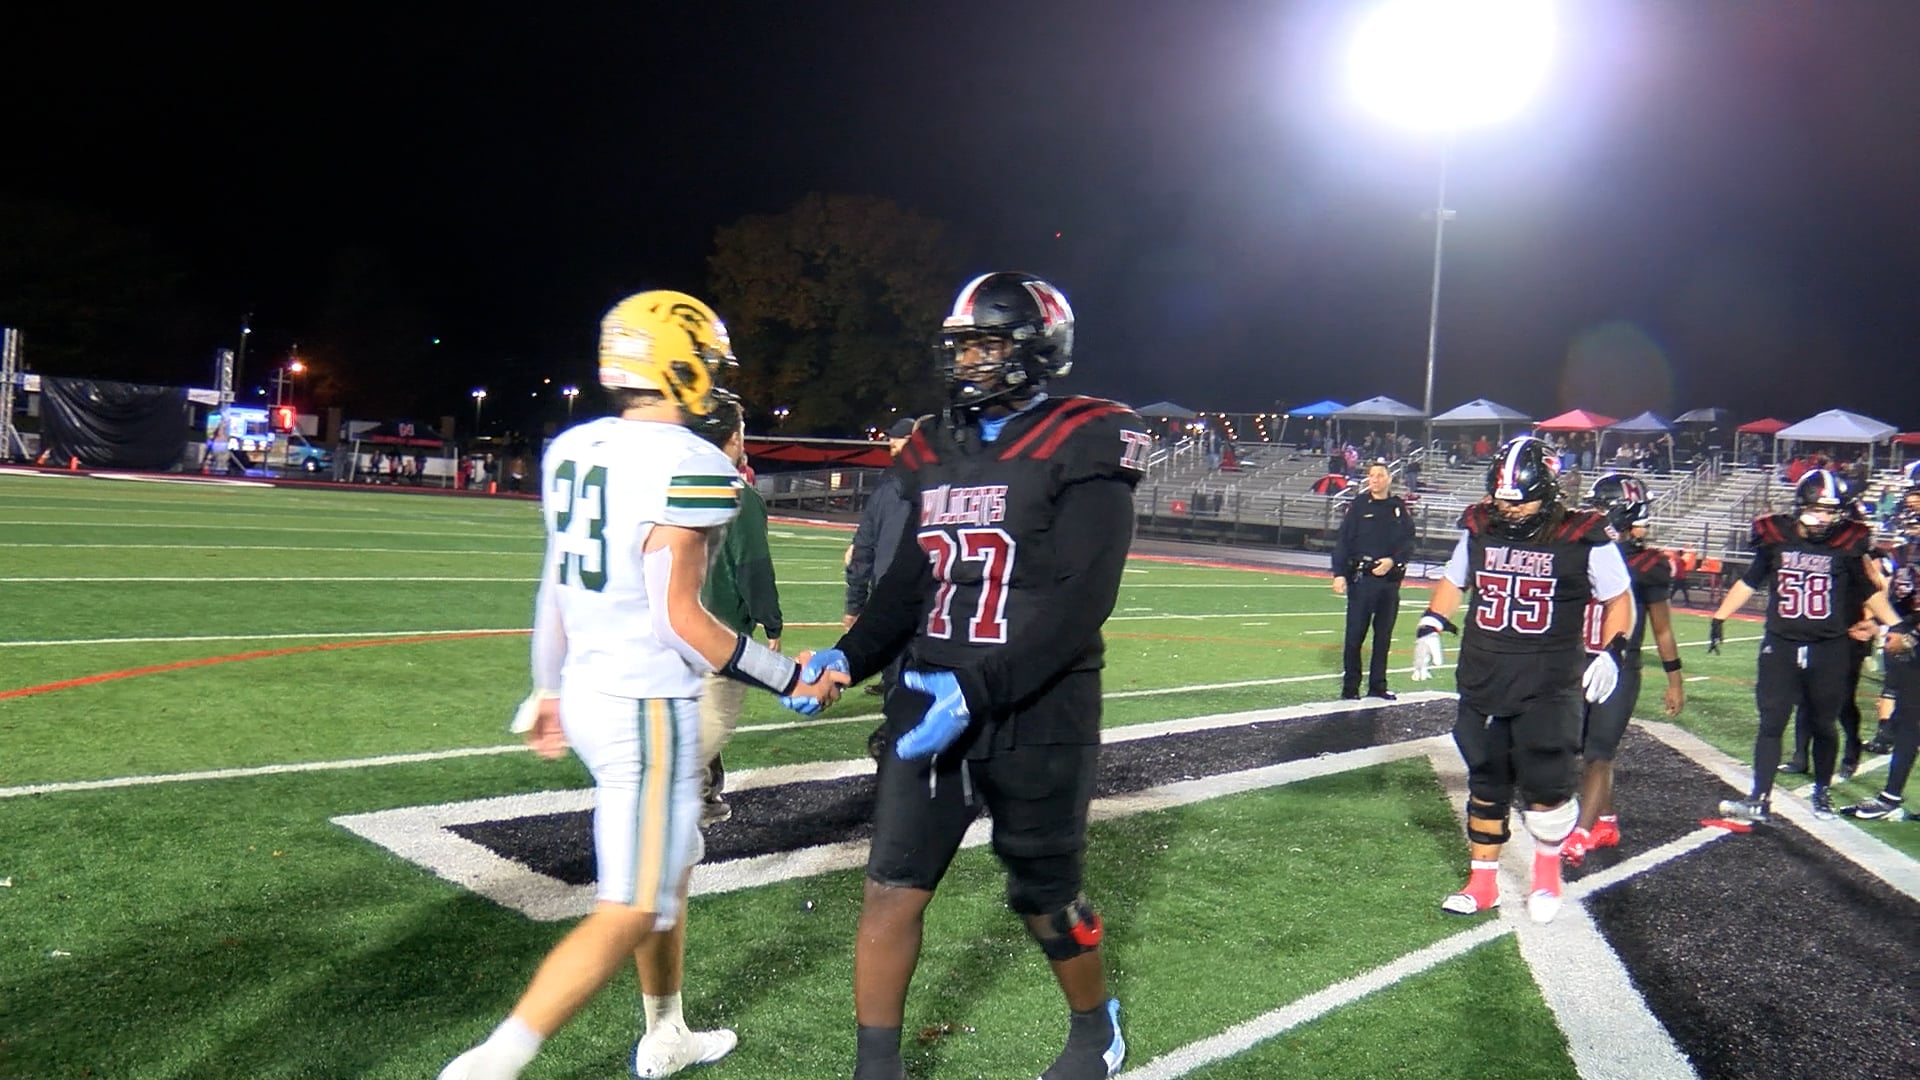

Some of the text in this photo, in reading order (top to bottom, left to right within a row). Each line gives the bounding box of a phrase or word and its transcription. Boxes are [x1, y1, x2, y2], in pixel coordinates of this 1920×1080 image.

[552, 459, 608, 592] 23
[920, 484, 1009, 527] WILDCATS
[917, 528, 1017, 643] 77
[1484, 546, 1555, 577] WILDCATS
[1475, 571, 1557, 633] 55
[1777, 569, 1833, 619] 58
